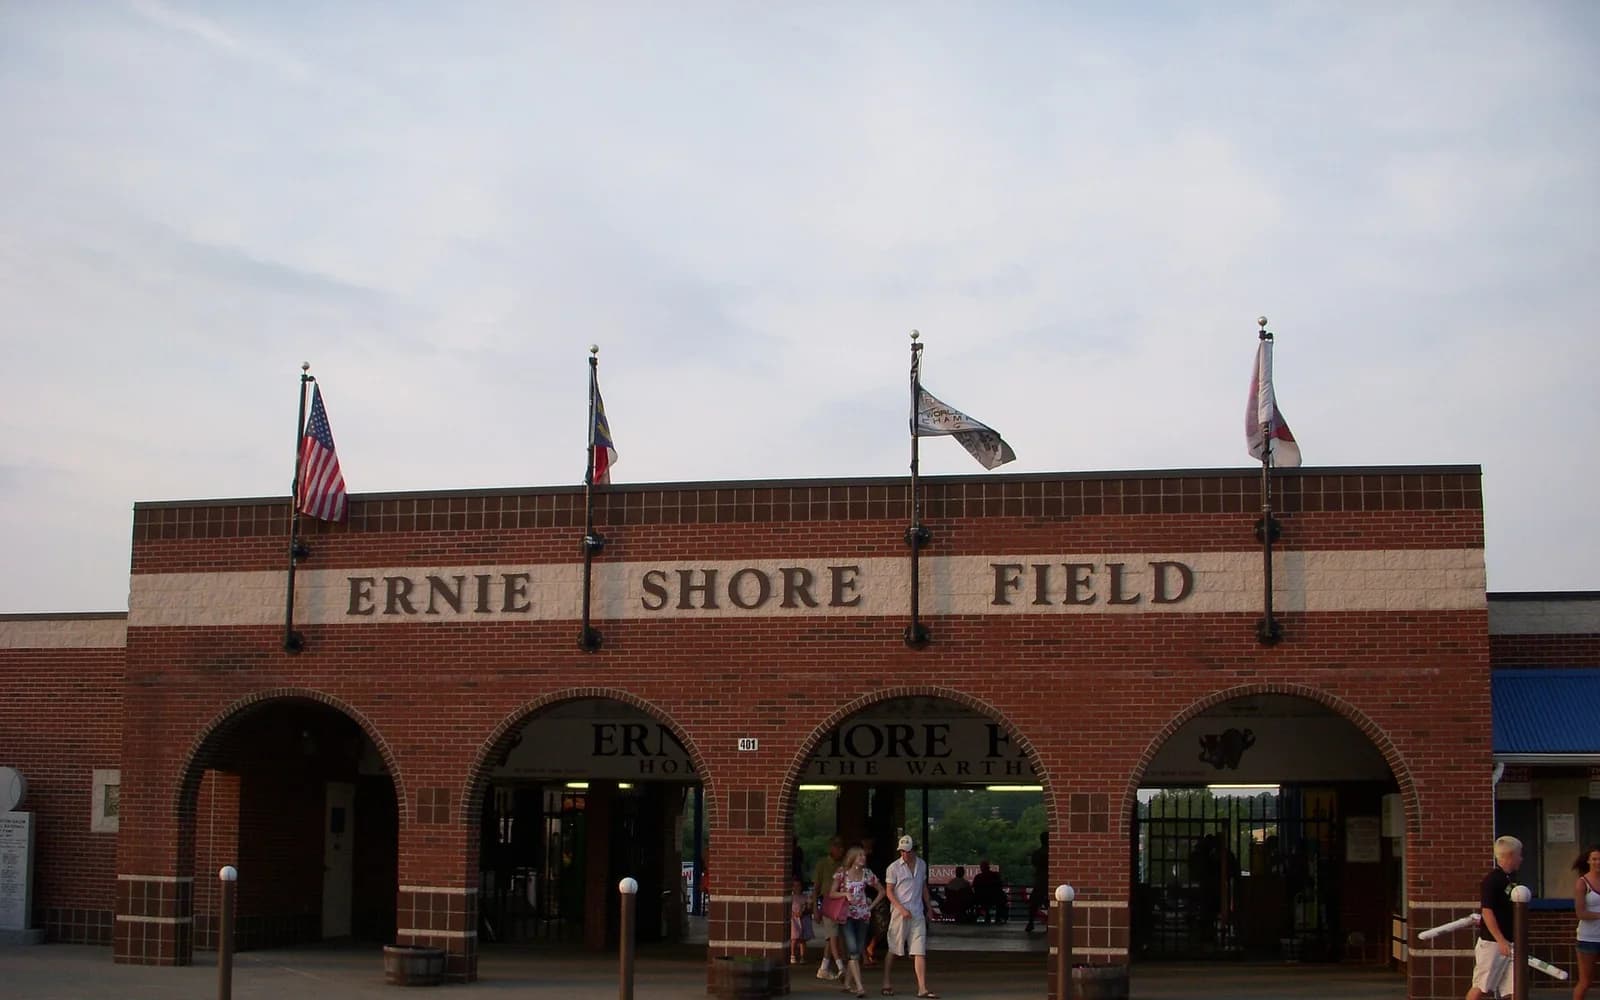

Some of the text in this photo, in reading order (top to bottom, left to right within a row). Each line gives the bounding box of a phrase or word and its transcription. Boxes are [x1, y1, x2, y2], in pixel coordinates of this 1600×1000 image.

[346, 561, 1193, 615] ERNIE SHORE FIELD
[740, 739, 755, 750] 401
[984, 723, 1028, 758] F
[815, 760, 878, 775] THE
